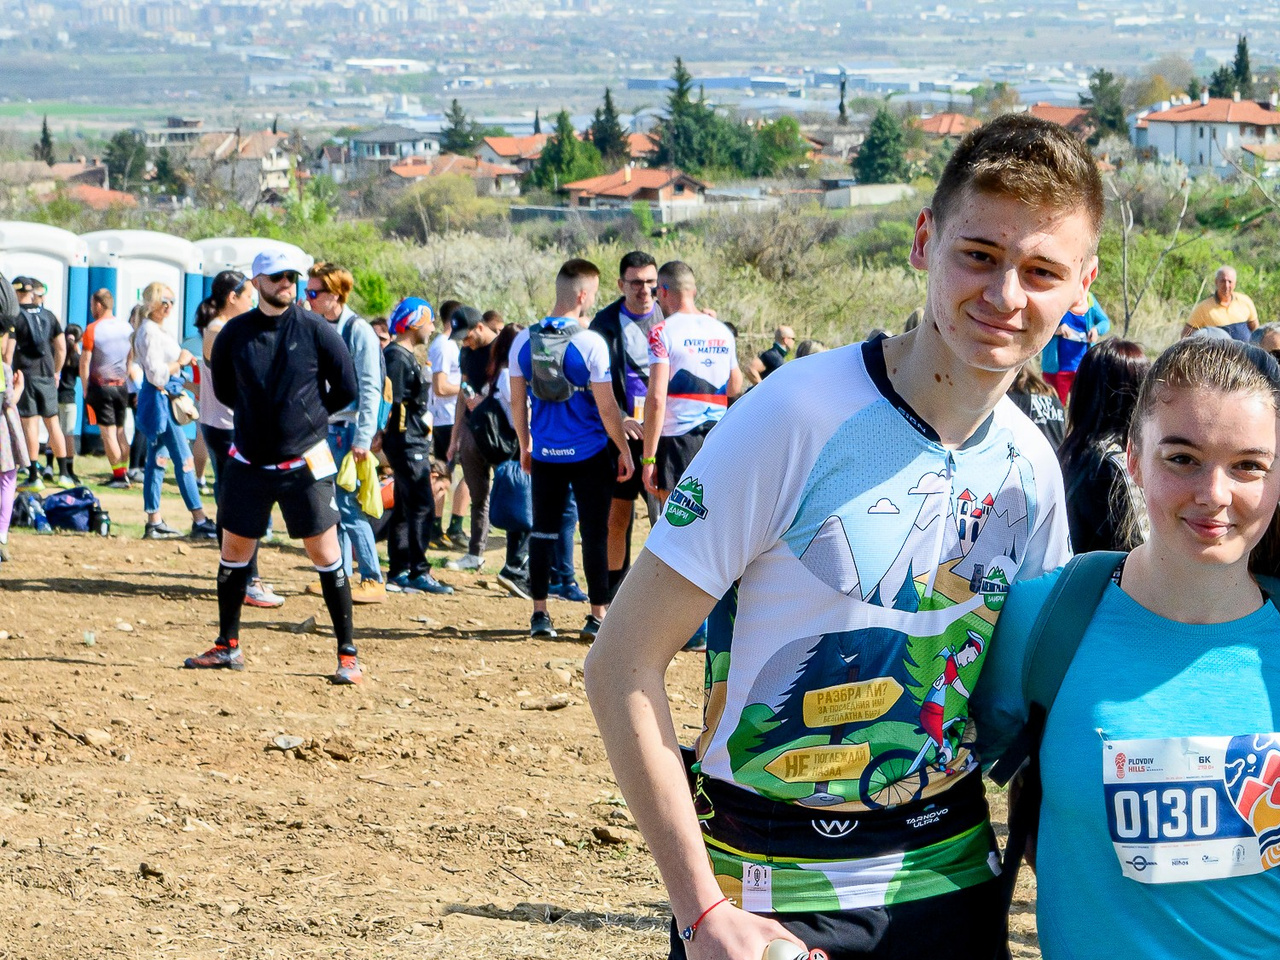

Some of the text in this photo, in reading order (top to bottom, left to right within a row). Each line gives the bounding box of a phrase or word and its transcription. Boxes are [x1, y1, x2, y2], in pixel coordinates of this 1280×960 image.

[684, 338, 727, 347] EVERY STEP
[697, 346, 729, 355] MATTERS
[816, 682, 888, 705] РАЗБРА ЛИ?
[817, 705, 828, 715] ЗА
[829, 699, 871, 714] ПОСЛЕДНИЯ
[823, 712, 862, 723] БЕЗПЛАТНА
[784, 754, 810, 778] НЕ
[1198, 756, 1211, 764] 6K
[811, 766, 842, 777] НАЗАД
[905, 808, 949, 825] TARNOVO
[1114, 787, 1217, 839] 0130
[913, 816, 940, 828] ULTRA
